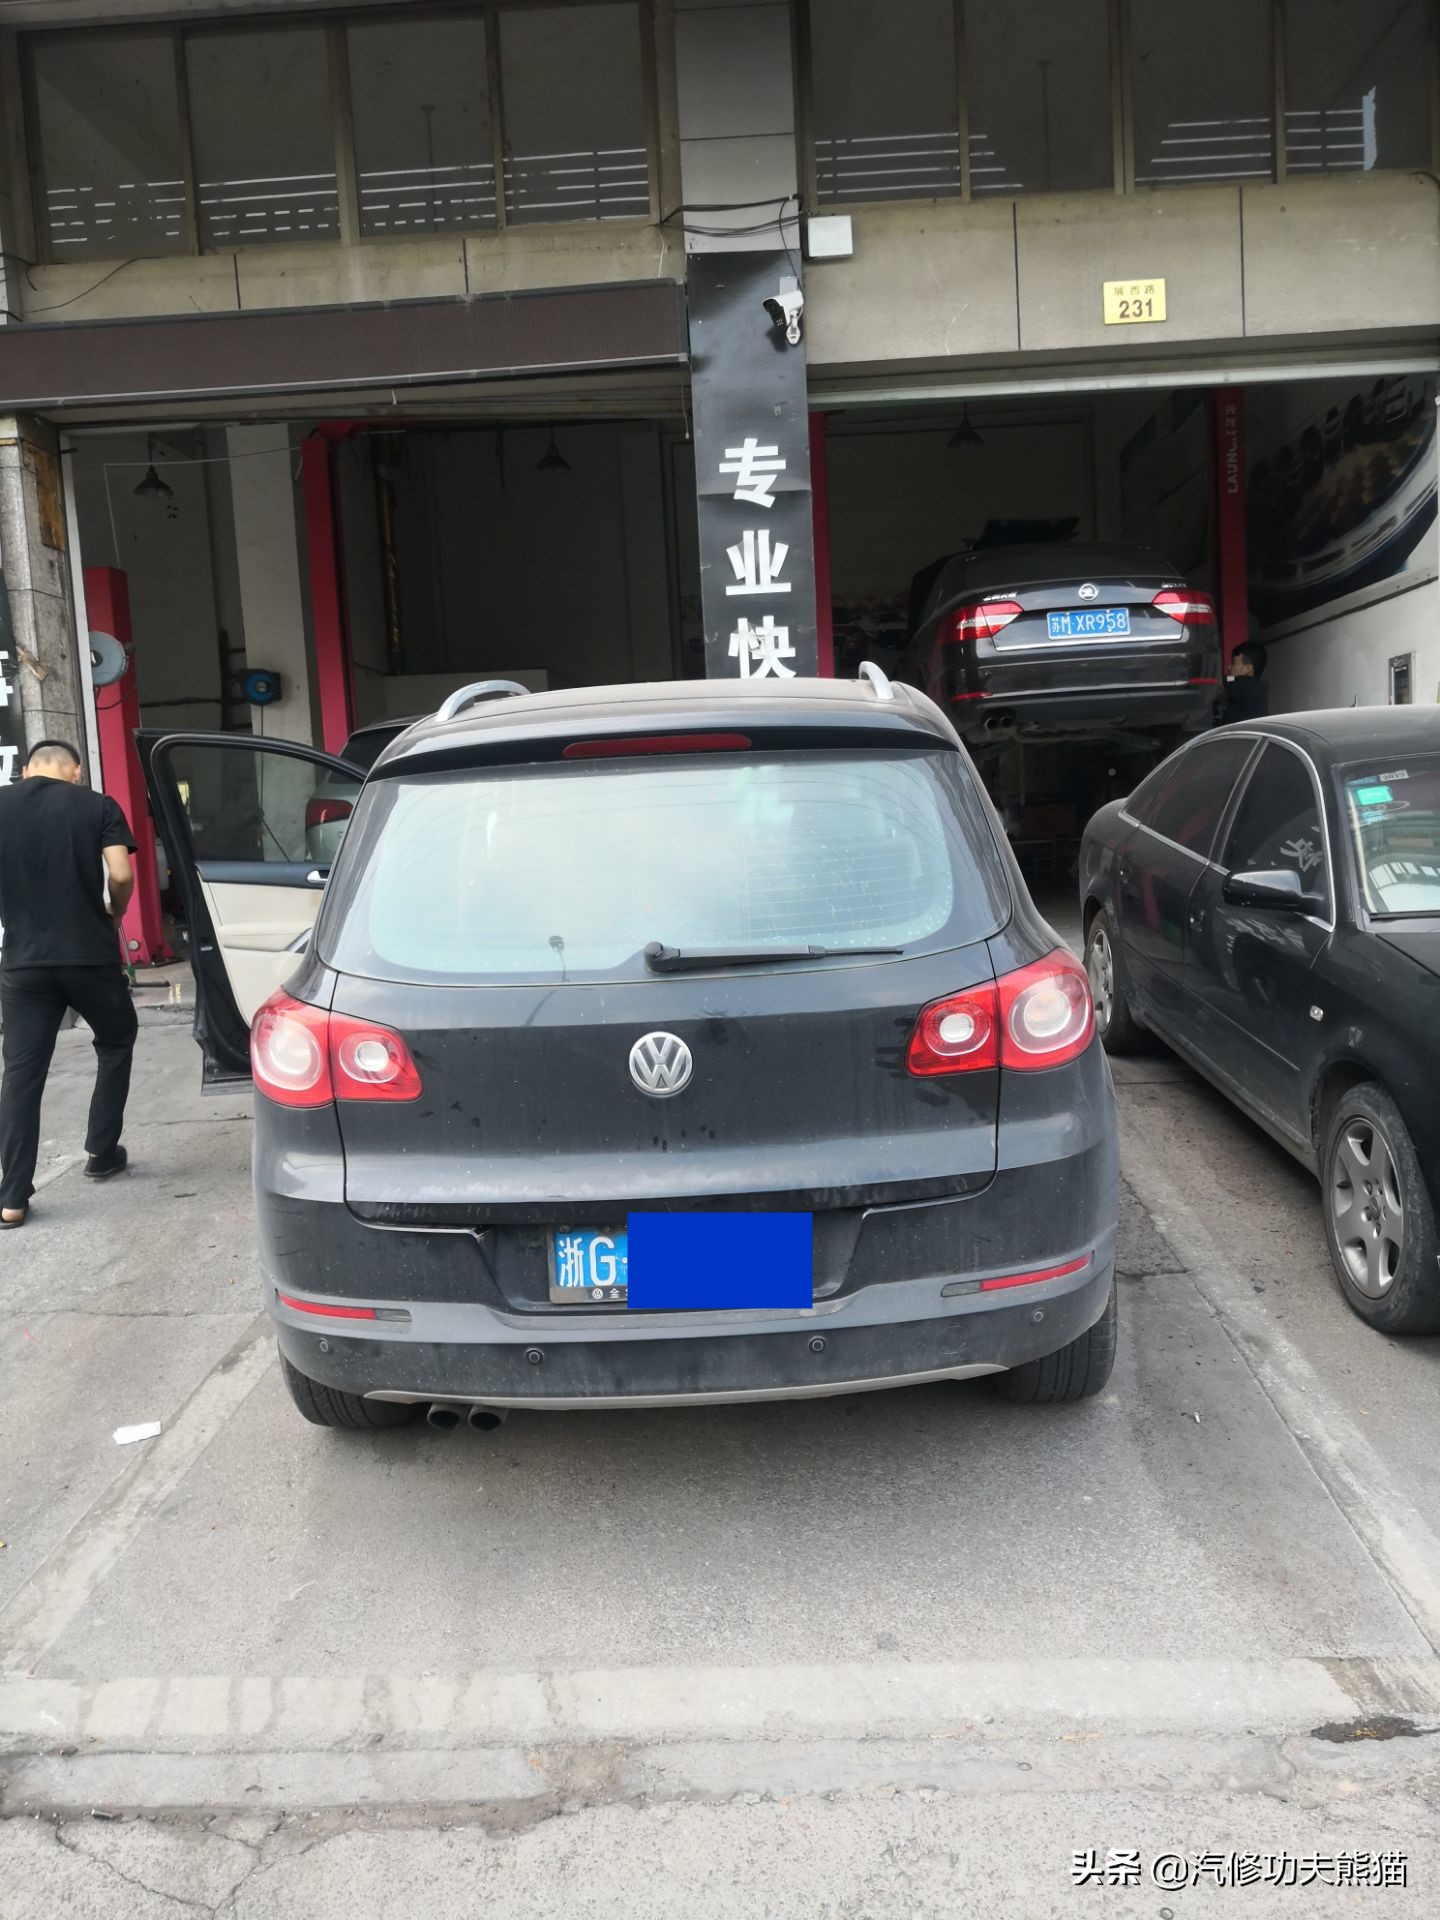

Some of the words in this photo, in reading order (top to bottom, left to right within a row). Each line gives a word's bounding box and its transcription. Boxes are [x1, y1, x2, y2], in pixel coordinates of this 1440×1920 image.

[1114, 285, 1155, 296] 城西路
[1119, 299, 1152, 318] 231
[719, 438, 797, 678] 专业快
